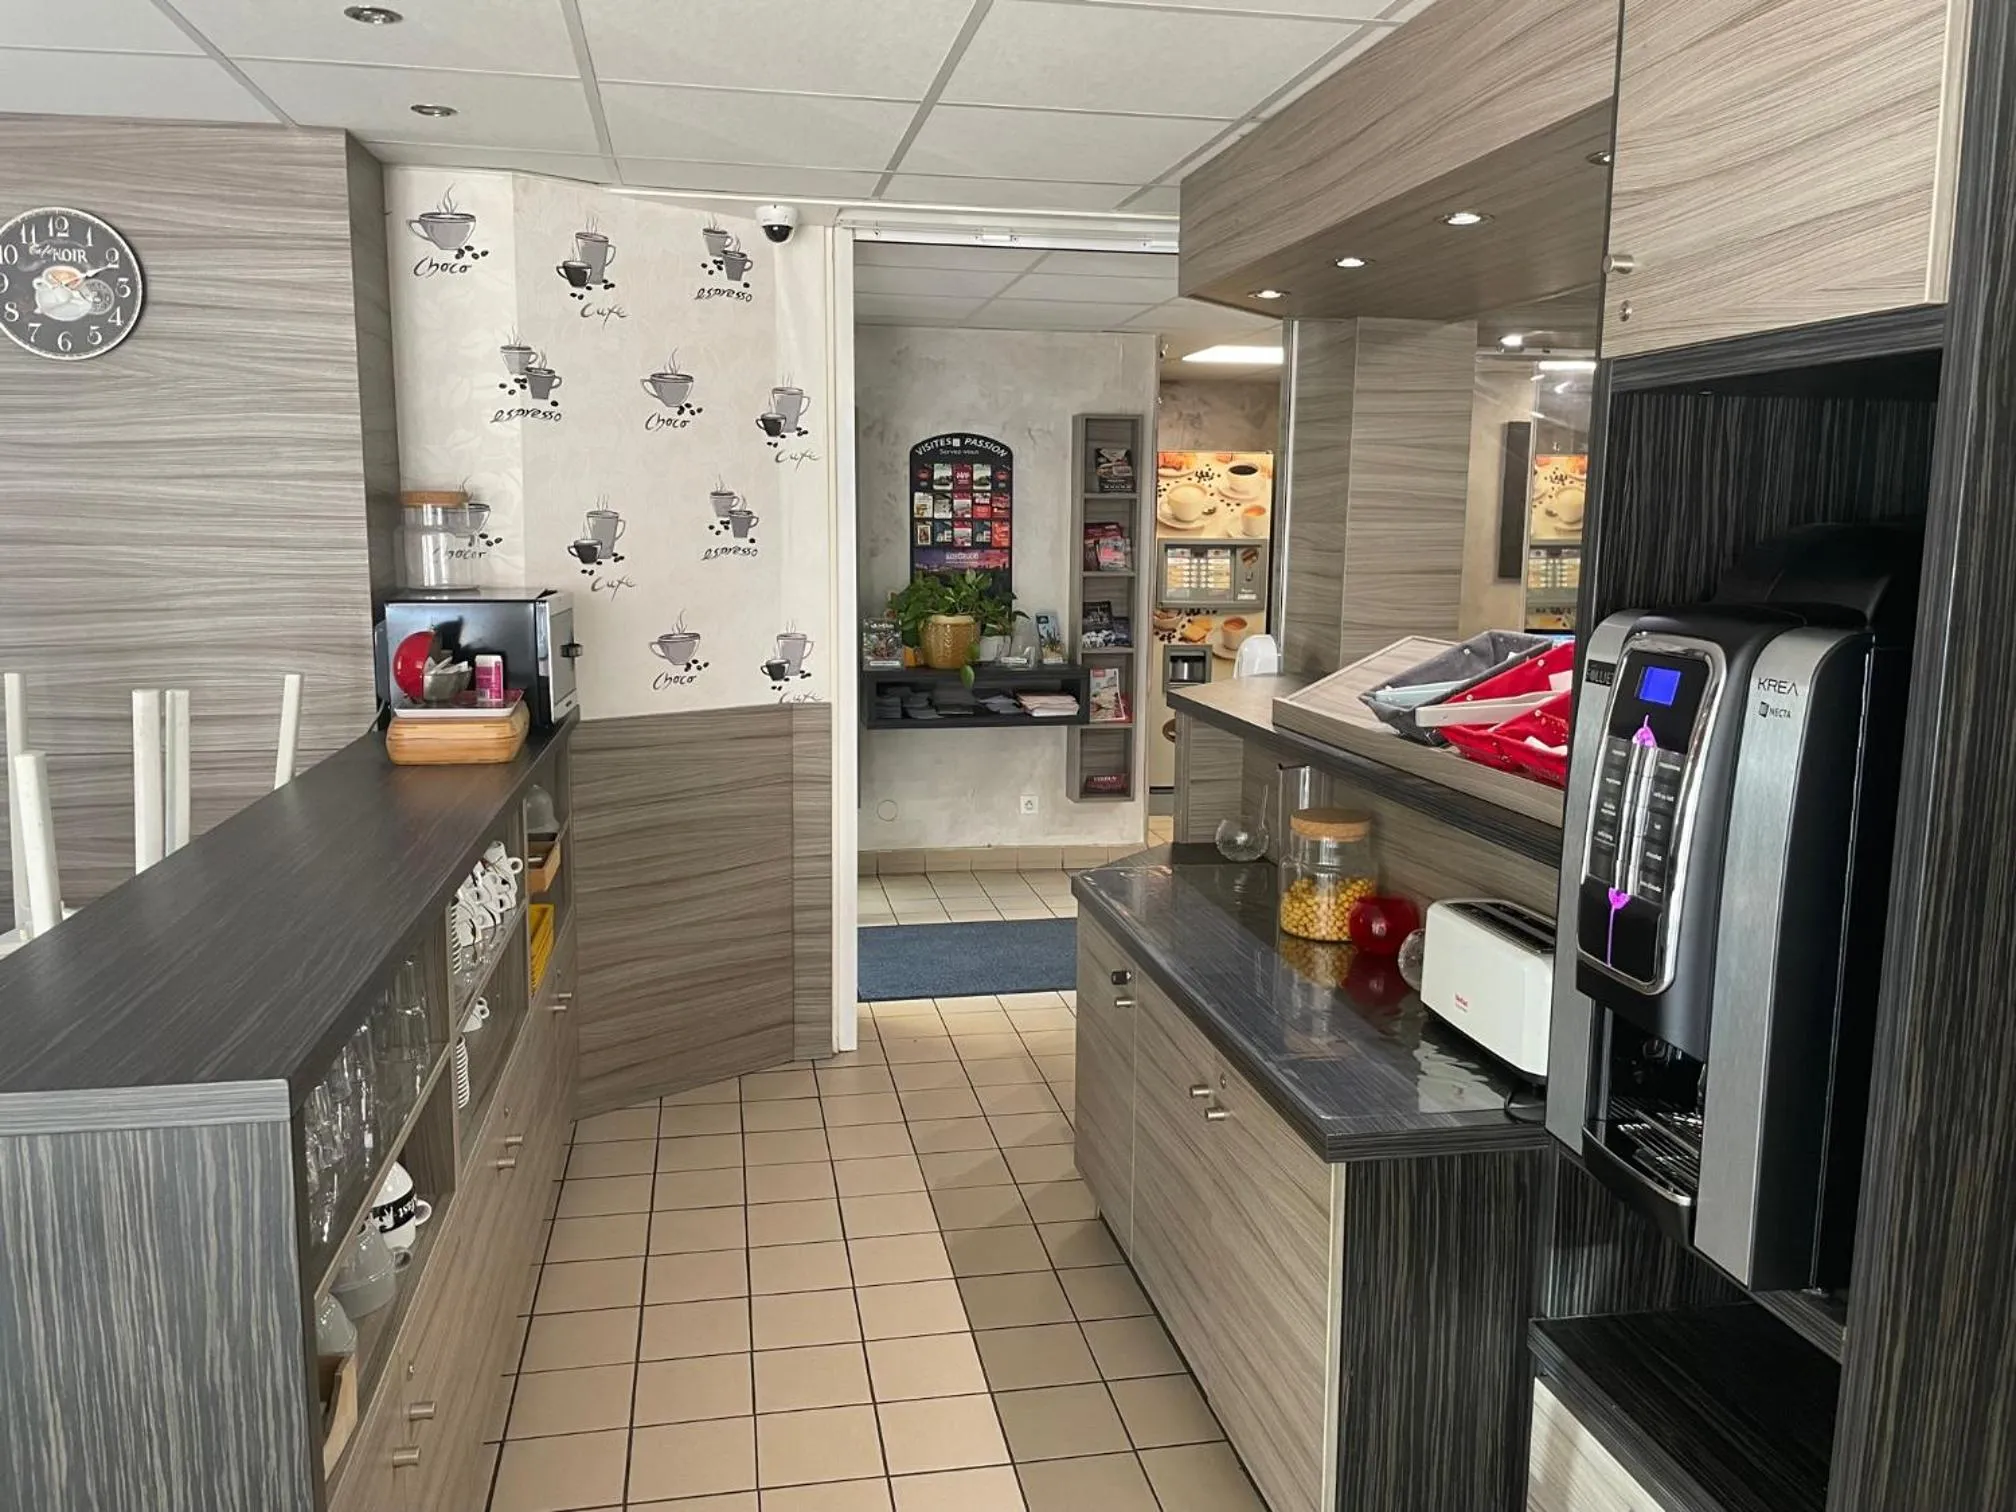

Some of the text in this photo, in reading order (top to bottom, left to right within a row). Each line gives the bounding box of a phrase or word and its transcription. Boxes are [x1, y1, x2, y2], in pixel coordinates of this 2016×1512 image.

[20, 223, 38, 244] 11
[48, 215, 70, 237] 12
[86, 226, 94, 247] 1
[52, 247, 88, 264] NOIR
[105, 247, 120, 269] 2
[413, 256, 472, 278] Choco
[115, 277, 132, 298] 3
[694, 287, 753, 303] espresso
[4, 301, 20, 322] 8
[107, 306, 125, 327] 4
[28, 322, 43, 343] 7
[57, 331, 73, 352] 6
[87, 325, 103, 346] 5
[489, 408, 562, 424] espresso
[645, 411, 691, 432] Choco
[915, 437, 1008, 458] VISITES PASSION
[700, 545, 758, 561] espresso
[652, 671, 697, 691] Choco
[1757, 676, 1799, 697] KREA
